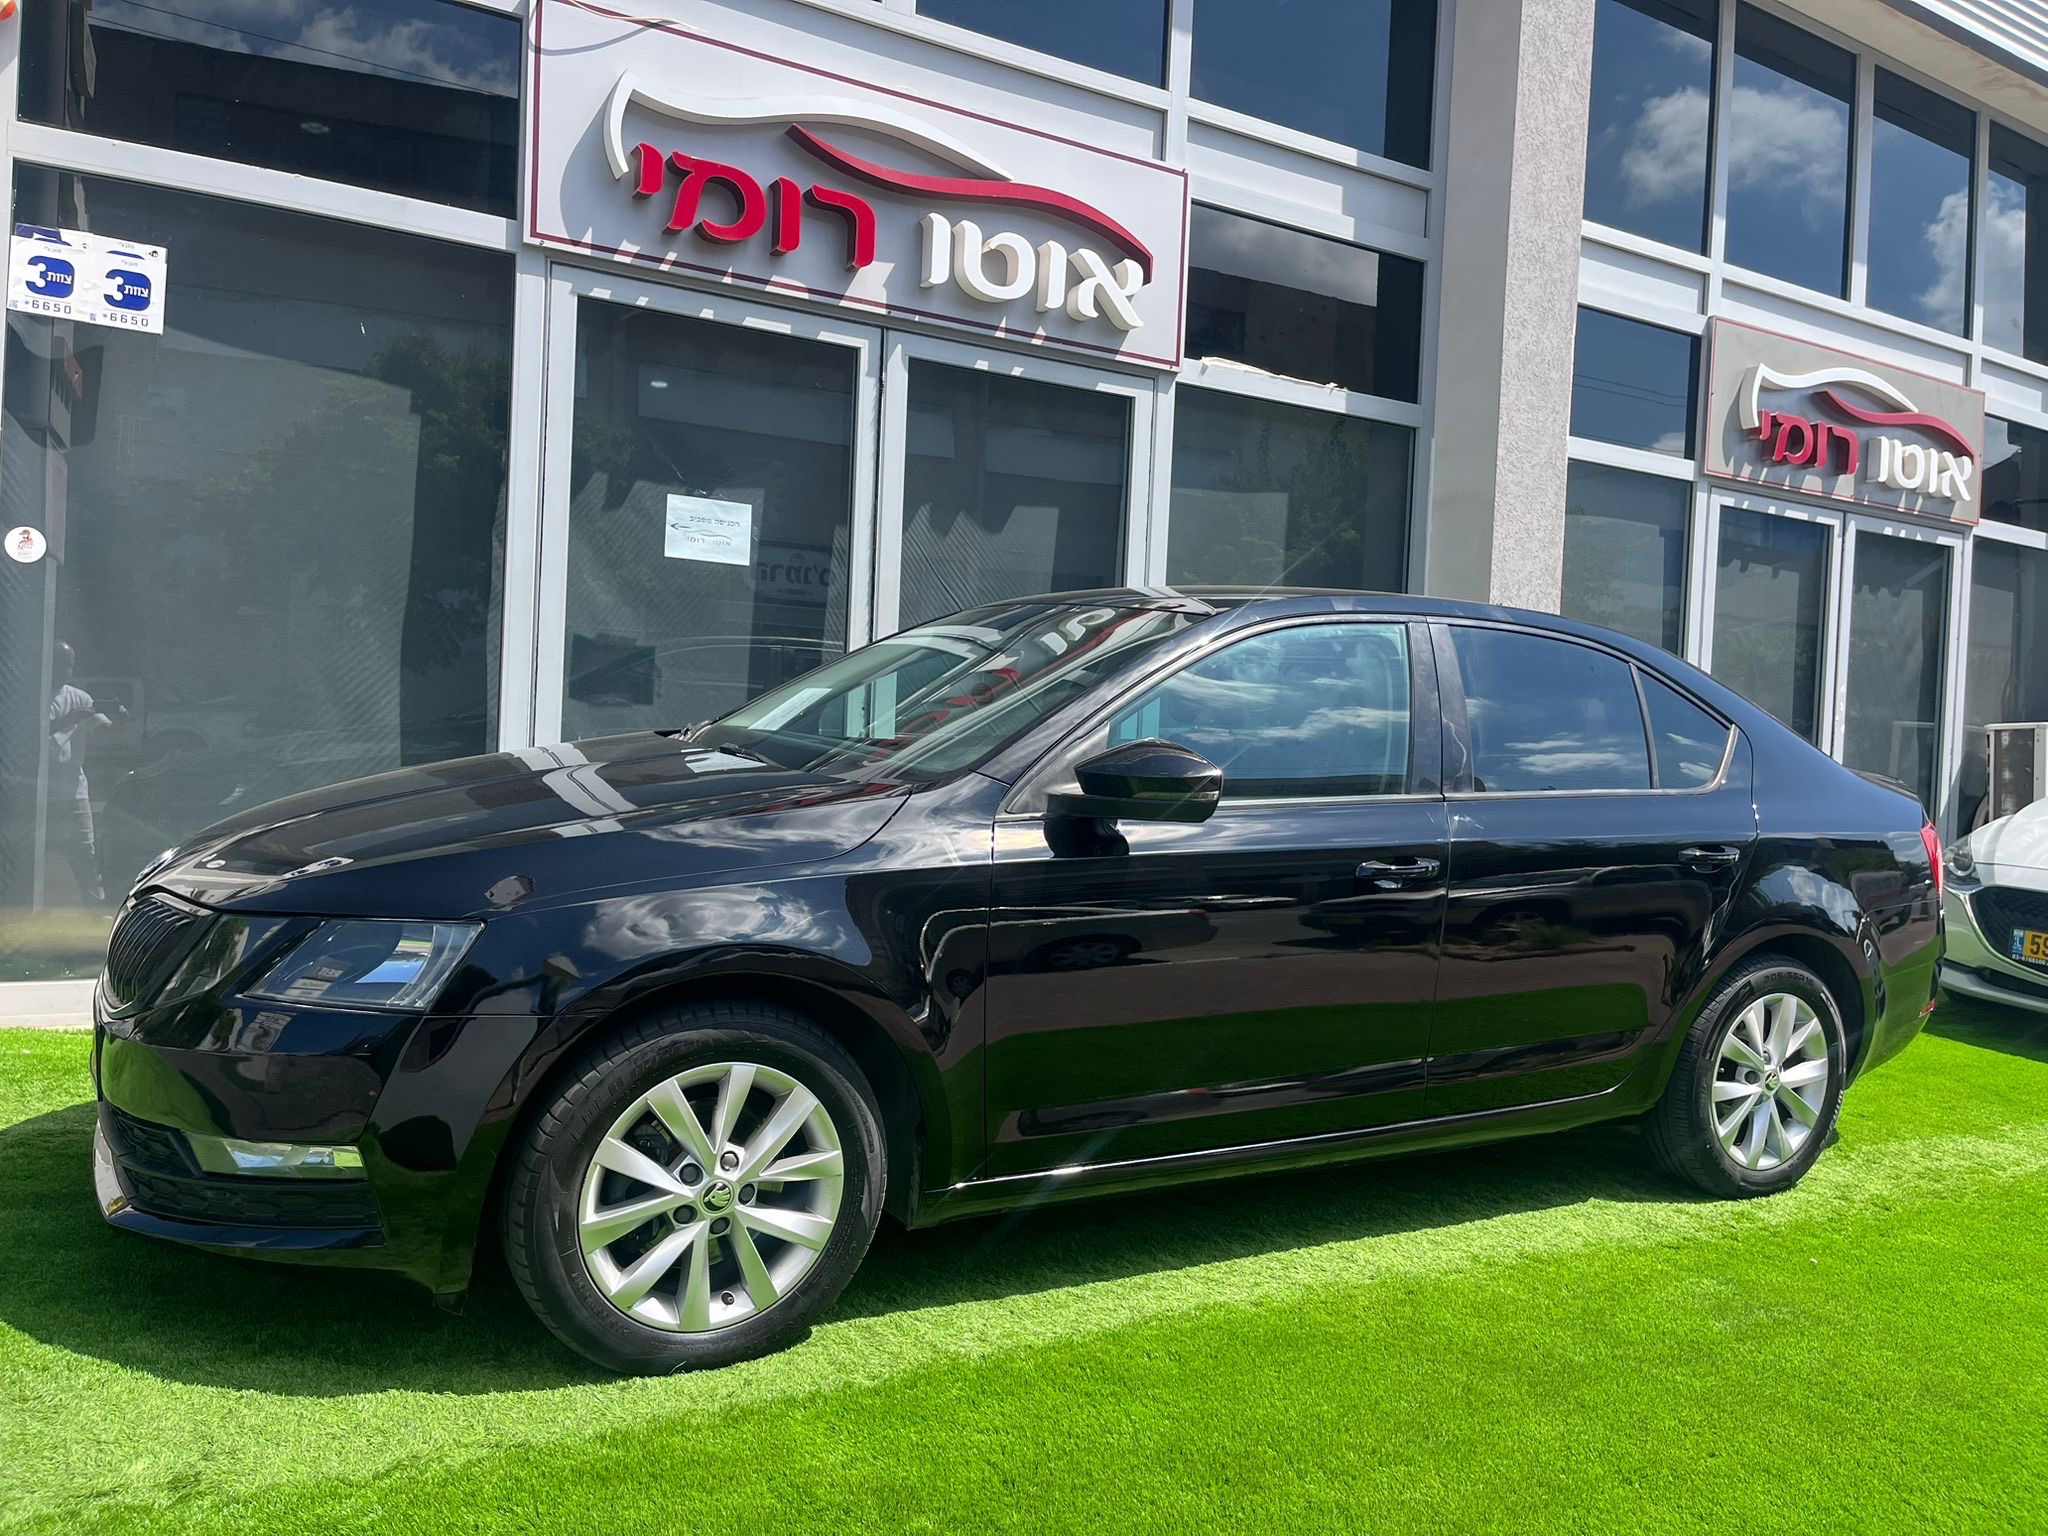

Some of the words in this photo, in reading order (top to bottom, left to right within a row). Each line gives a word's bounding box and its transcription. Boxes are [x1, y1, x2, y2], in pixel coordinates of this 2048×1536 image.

[631, 141, 877, 271] רומי
[26, 262, 47, 289] 3
[46, 271, 73, 285] צוות
[920, 211, 1145, 331] אוטו
[104, 276, 125, 302] 3
[123, 284, 149, 298] צוות
[1753, 408, 1860, 477] רומי
[1868, 435, 1973, 501] אוטו
[688, 515, 712, 524] מסביב
